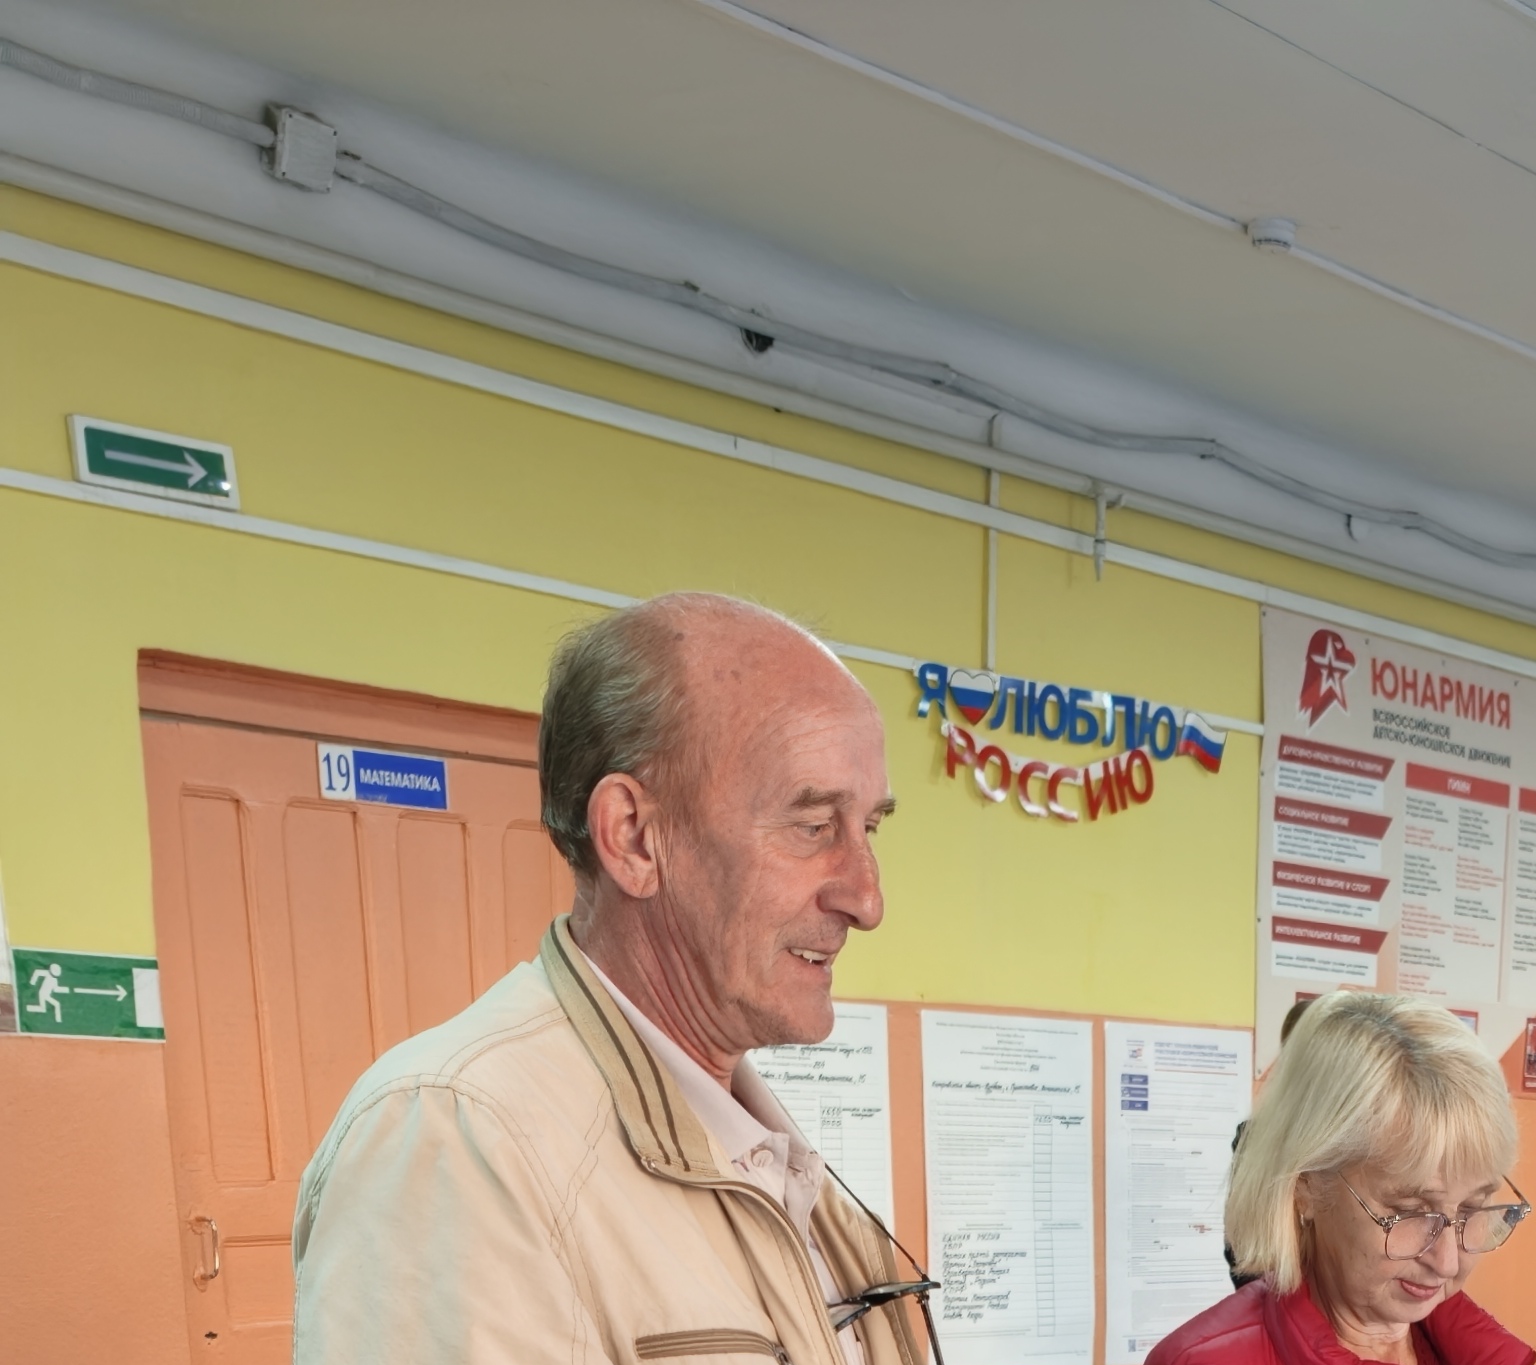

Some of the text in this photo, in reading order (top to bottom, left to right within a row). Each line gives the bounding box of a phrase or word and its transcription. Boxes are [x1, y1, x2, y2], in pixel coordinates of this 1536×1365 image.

[917, 662, 1176, 760] Я ЛЮБЛЮ
[1371, 657, 1510, 730] ЮНАРМИЯ
[322, 752, 441, 792] 19 МАТЕМАТИКА
[945, 724, 1154, 823] РОССИЮ
